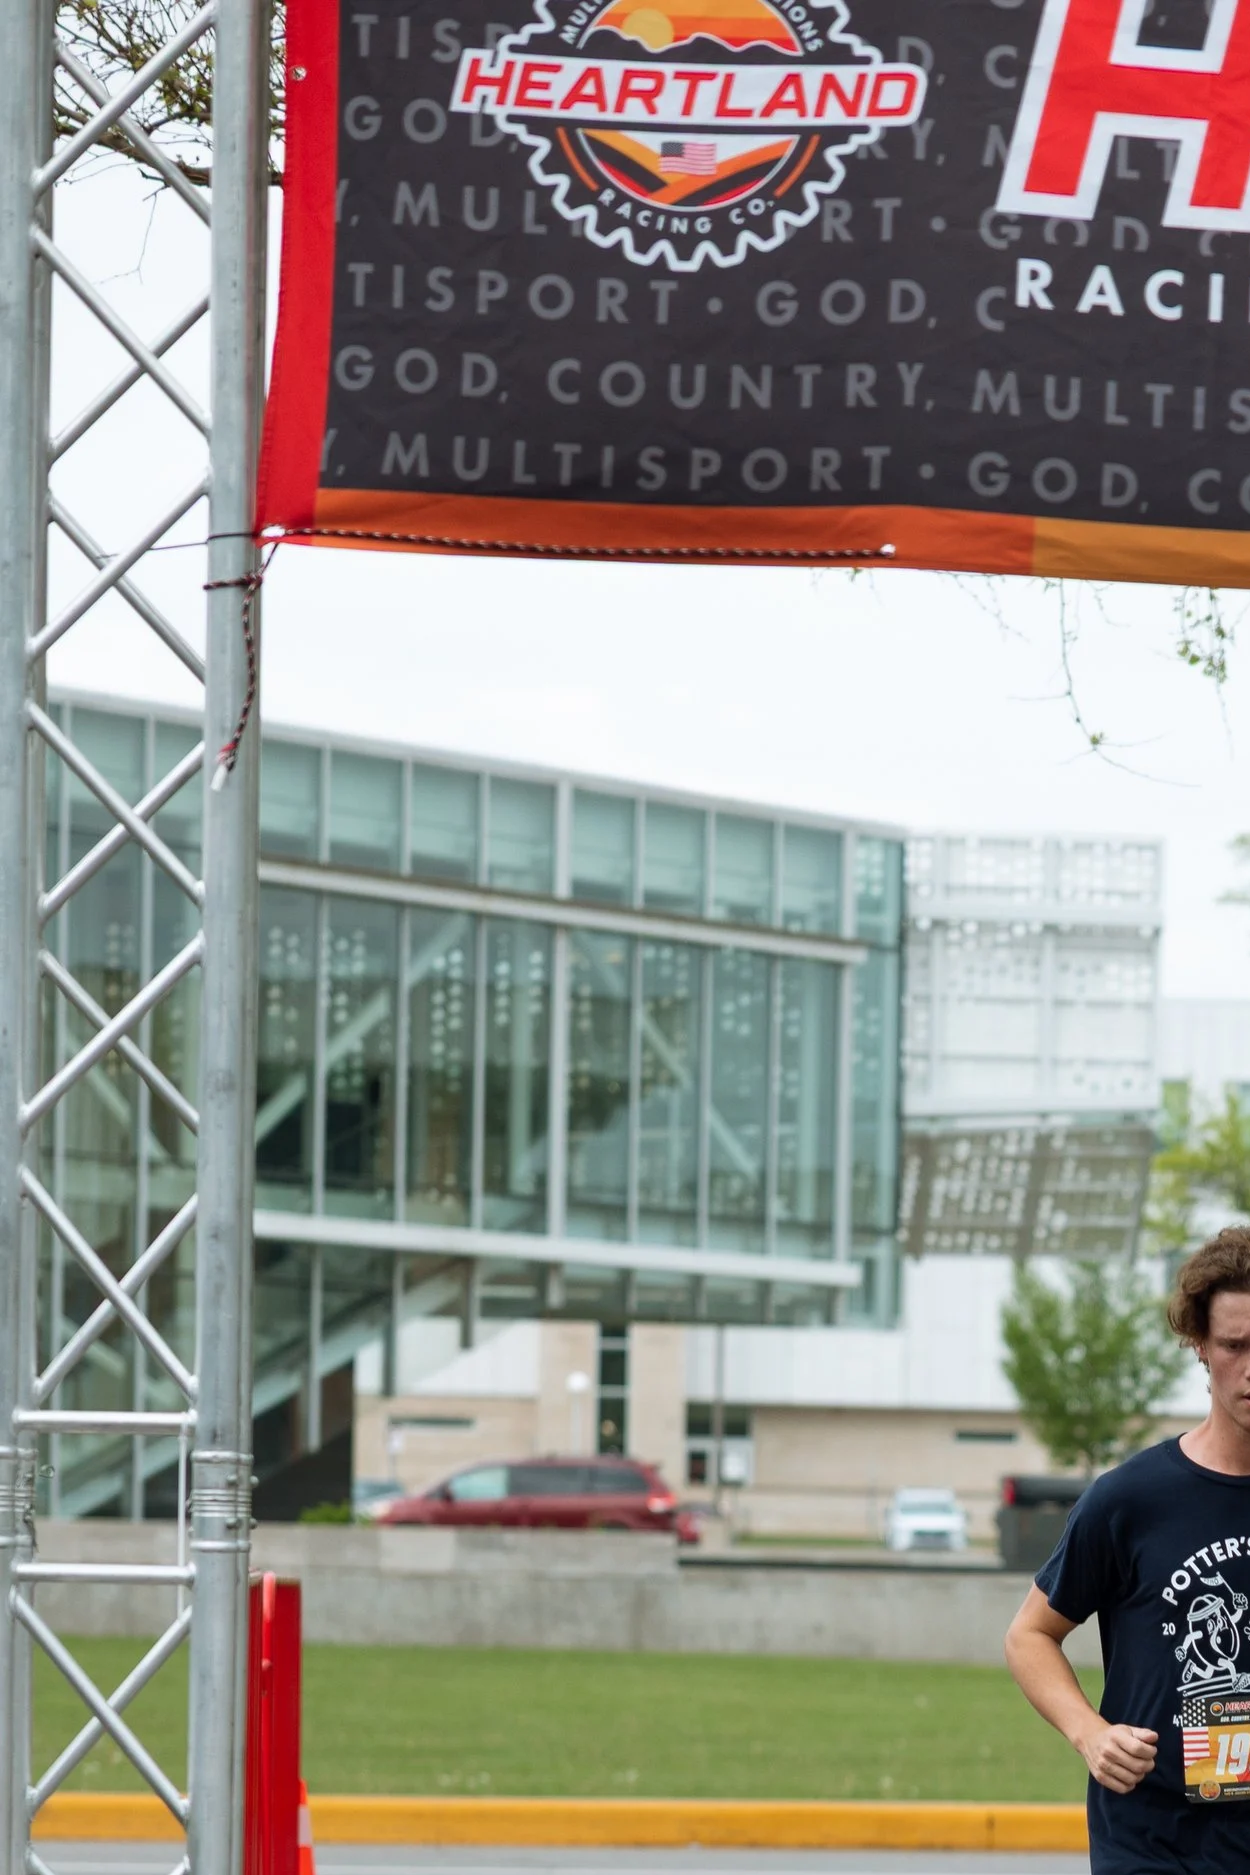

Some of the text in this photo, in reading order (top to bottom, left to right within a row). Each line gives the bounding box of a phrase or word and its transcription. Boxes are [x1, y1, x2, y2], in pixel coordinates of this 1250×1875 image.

[461, 57, 919, 119] HEARTLAND
[598, 187, 713, 235] RACING
[347, 263, 679, 326] TISPORT
[755, 280, 937, 327] GOD,
[335, 346, 508, 401] GOD,
[547, 358, 935, 411] COUNTRY,
[381, 430, 890, 491] MULTISPORT
[967, 451, 1150, 513] GOD,
[1162, 1622, 1176, 1636] 20
